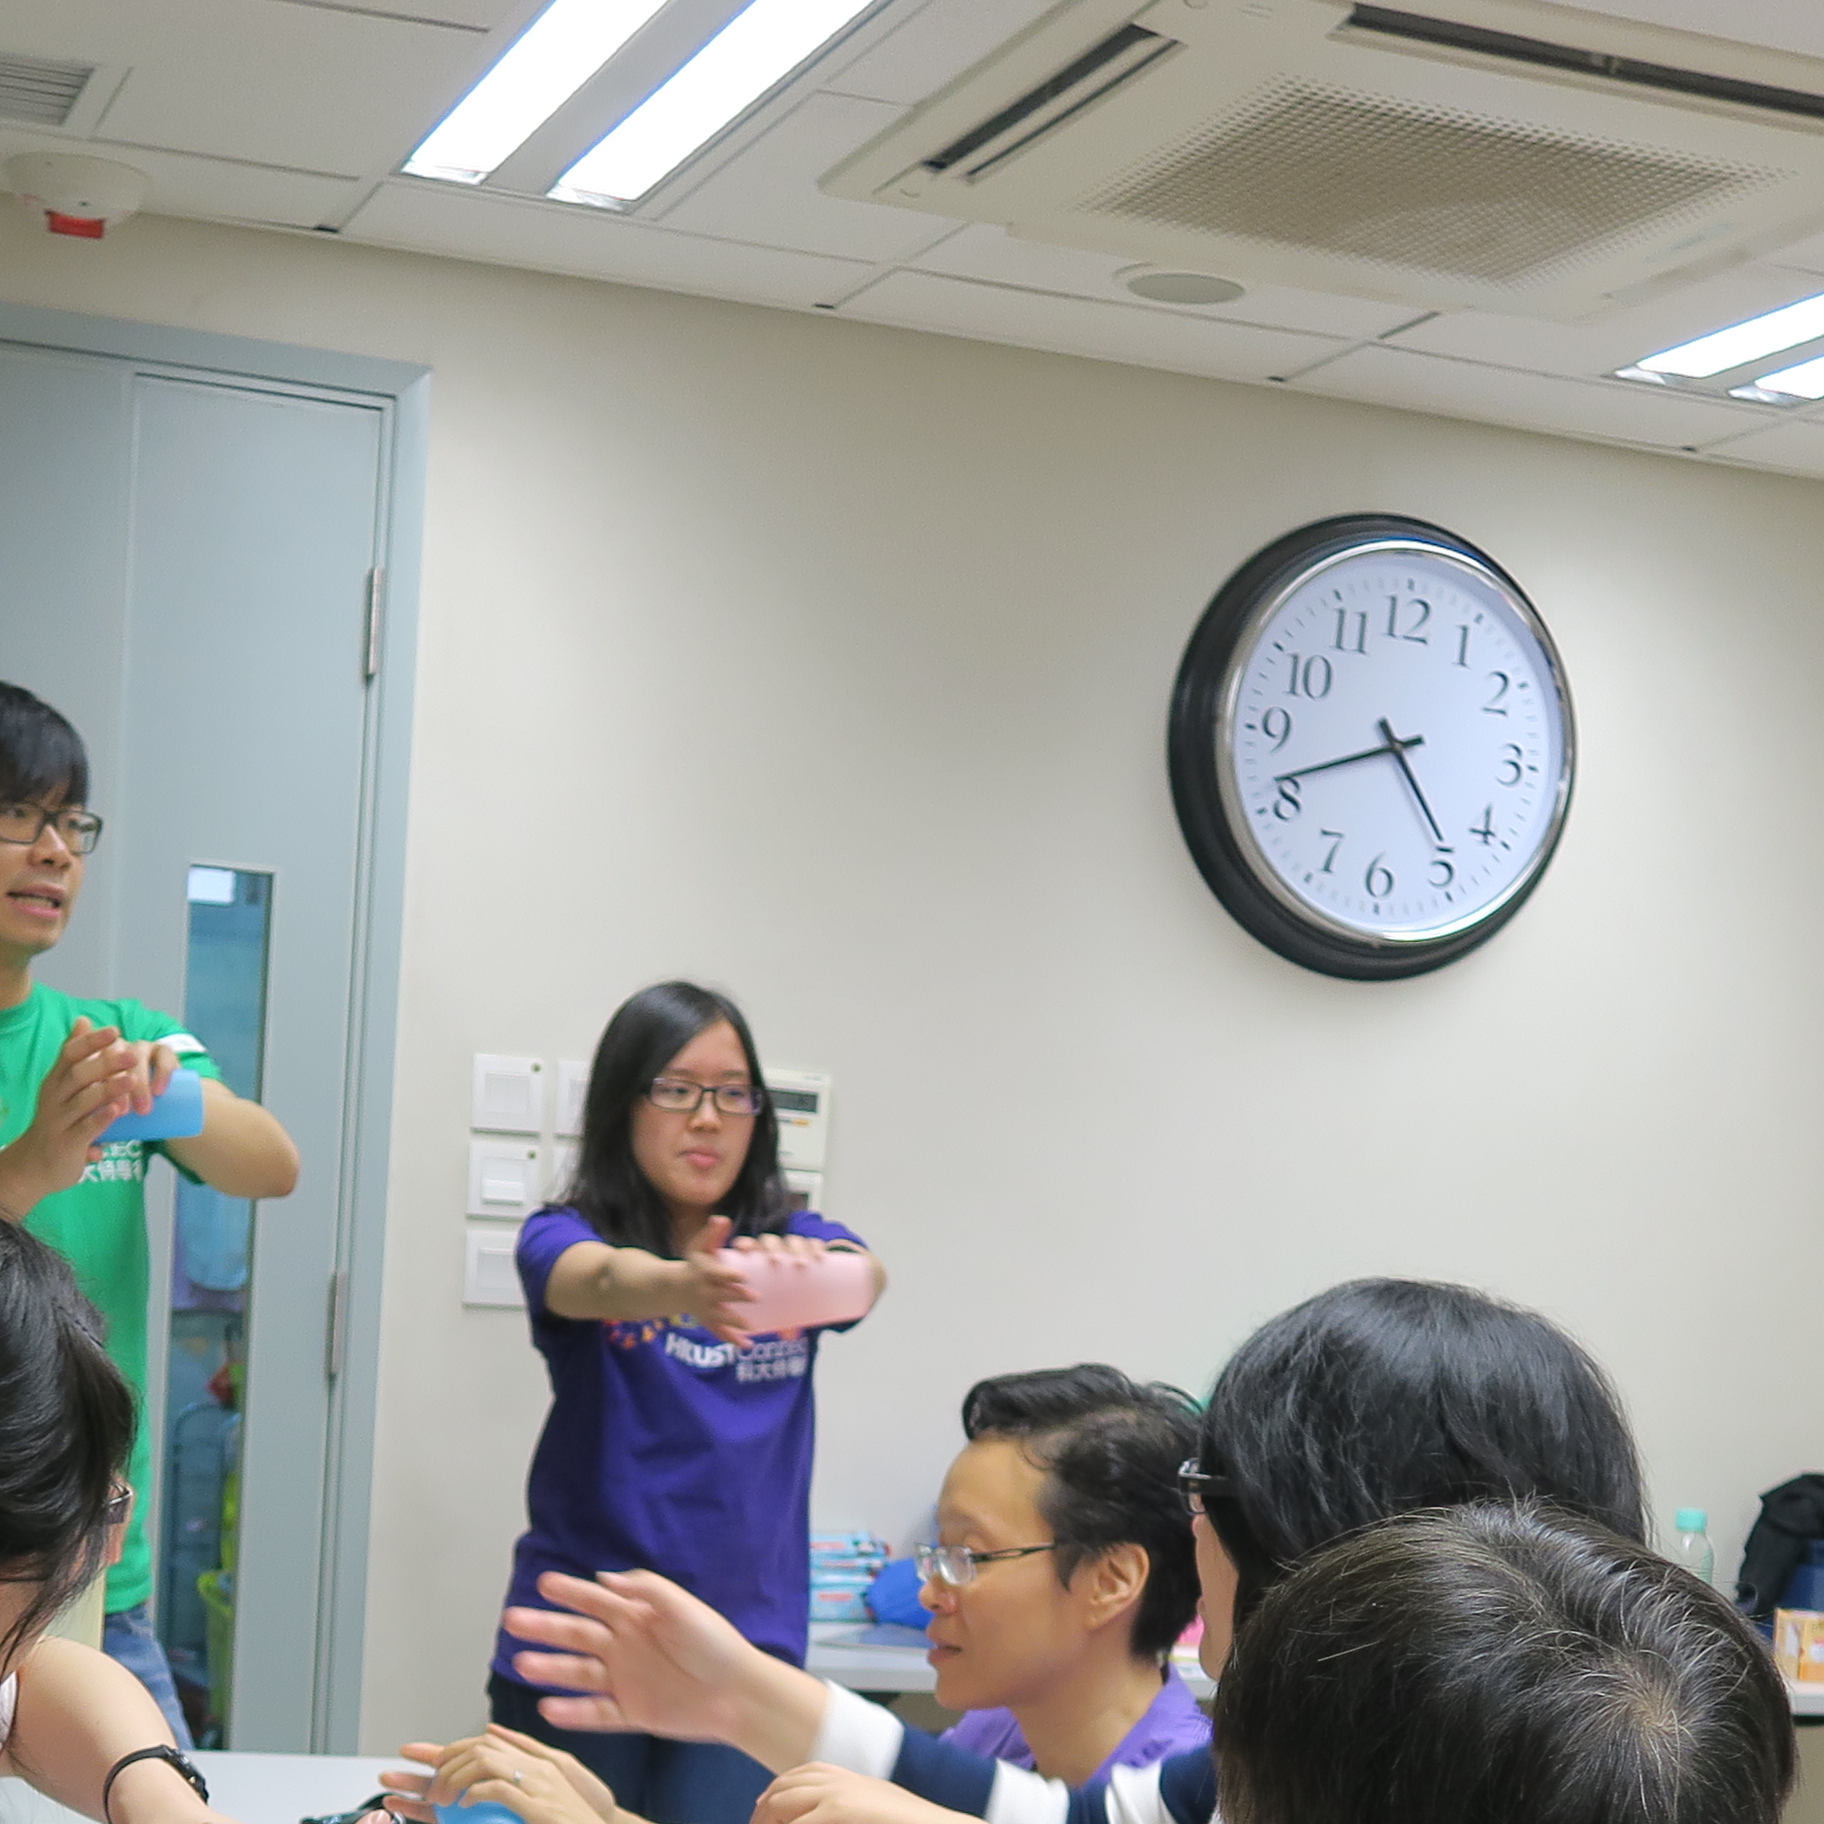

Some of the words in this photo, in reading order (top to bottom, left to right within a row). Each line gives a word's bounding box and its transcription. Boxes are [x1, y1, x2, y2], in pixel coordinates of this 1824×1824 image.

[1330, 607, 1368, 655] 11
[1383, 595, 1430, 645] 12
[1452, 624, 1470, 670] 1
[1285, 652, 1334, 700] 10
[1481, 670, 1509, 717] 2
[1262, 706, 1291, 753] 9
[1496, 742, 1523, 787] 3
[1273, 775, 1301, 821] 8
[1468, 803, 1495, 845] 4
[1320, 828, 1344, 873] 7
[1428, 846, 1455, 888] 5
[1366, 853, 1394, 897] 6
